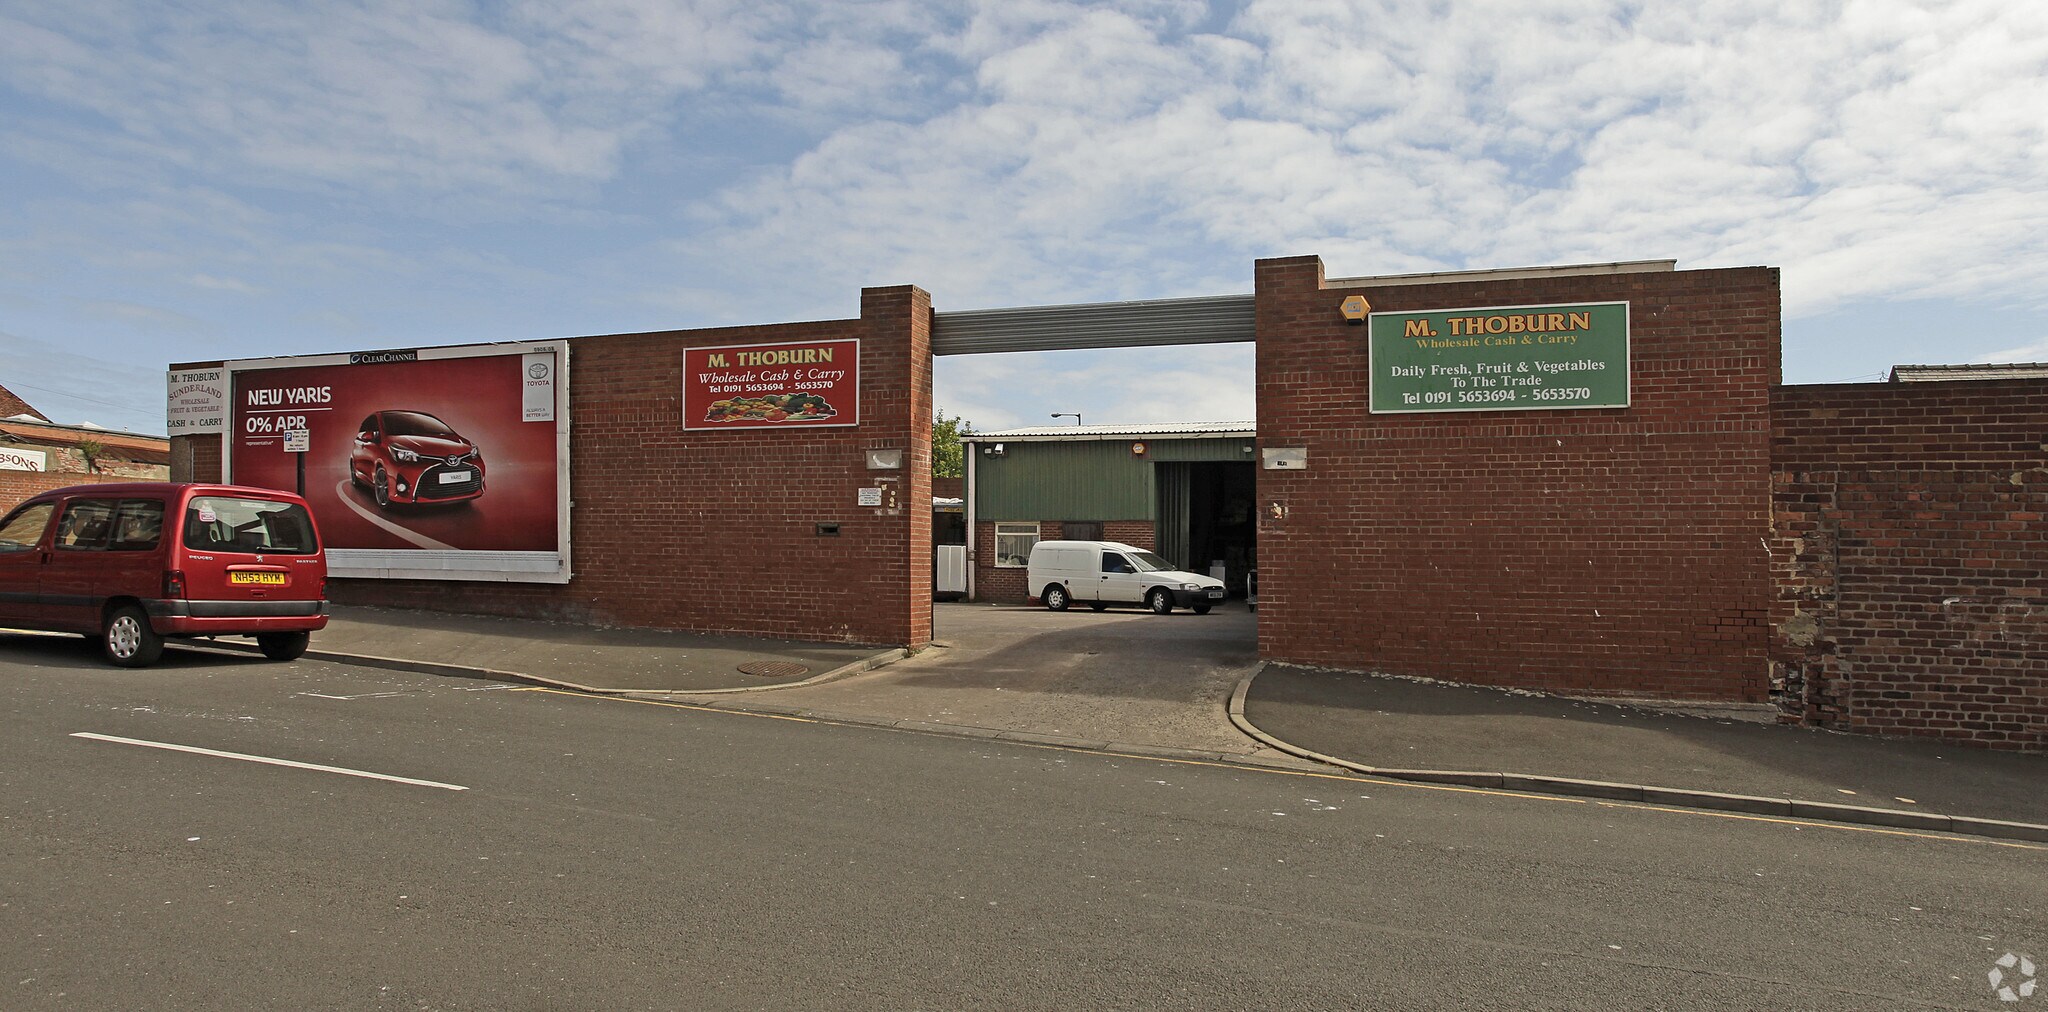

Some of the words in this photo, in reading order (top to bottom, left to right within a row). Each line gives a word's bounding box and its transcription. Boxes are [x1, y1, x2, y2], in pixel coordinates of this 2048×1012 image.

[1404, 319, 1438, 338] M.
[1447, 311, 1591, 336] THOBURN
[1416, 337, 1480, 349] Wholesale
[1484, 335, 1516, 347] Cash
[1521, 334, 1533, 345] &
[1538, 333, 1578, 345] Carry
[707, 353, 730, 368] M.
[736, 347, 833, 366] THOBURN
[699, 370, 756, 384] Wholesale
[760, 369, 789, 381] Cash
[793, 369, 804, 380] &
[807, 368, 845, 381] Carry
[1391, 365, 1426, 379] Daily
[1431, 363, 1472, 376] Fresh,
[1477, 362, 1512, 374] Fruit
[1516, 361, 1529, 373] &
[1534, 359, 1606, 375] Vegetables
[170, 375, 180, 383] M.
[182, 372, 221, 382] THOBURN
[1450, 377, 1466, 388] To
[1471, 376, 1497, 387] The
[1500, 375, 1542, 386] Trade
[168, 384, 222, 401] SUNDERLAND
[709, 385, 721, 393] Tel
[723, 384, 742, 393] 0191
[745, 383, 784, 392] 5653694
[794, 380, 834, 390] 5653570
[248, 388, 283, 406] NEW
[285, 386, 332, 404] YARIS
[1402, 392, 1420, 404] Tel
[1424, 391, 1451, 403] 0191
[1458, 389, 1516, 402] 5653694
[1532, 387, 1591, 401] 5653570
[167, 420, 186, 428] CASH
[199, 418, 223, 426] CARRY
[246, 417, 273, 433] 0%
[275, 415, 307, 432] APR
[235, 573, 261, 582] NH53
[262, 574, 281, 583] HYM
